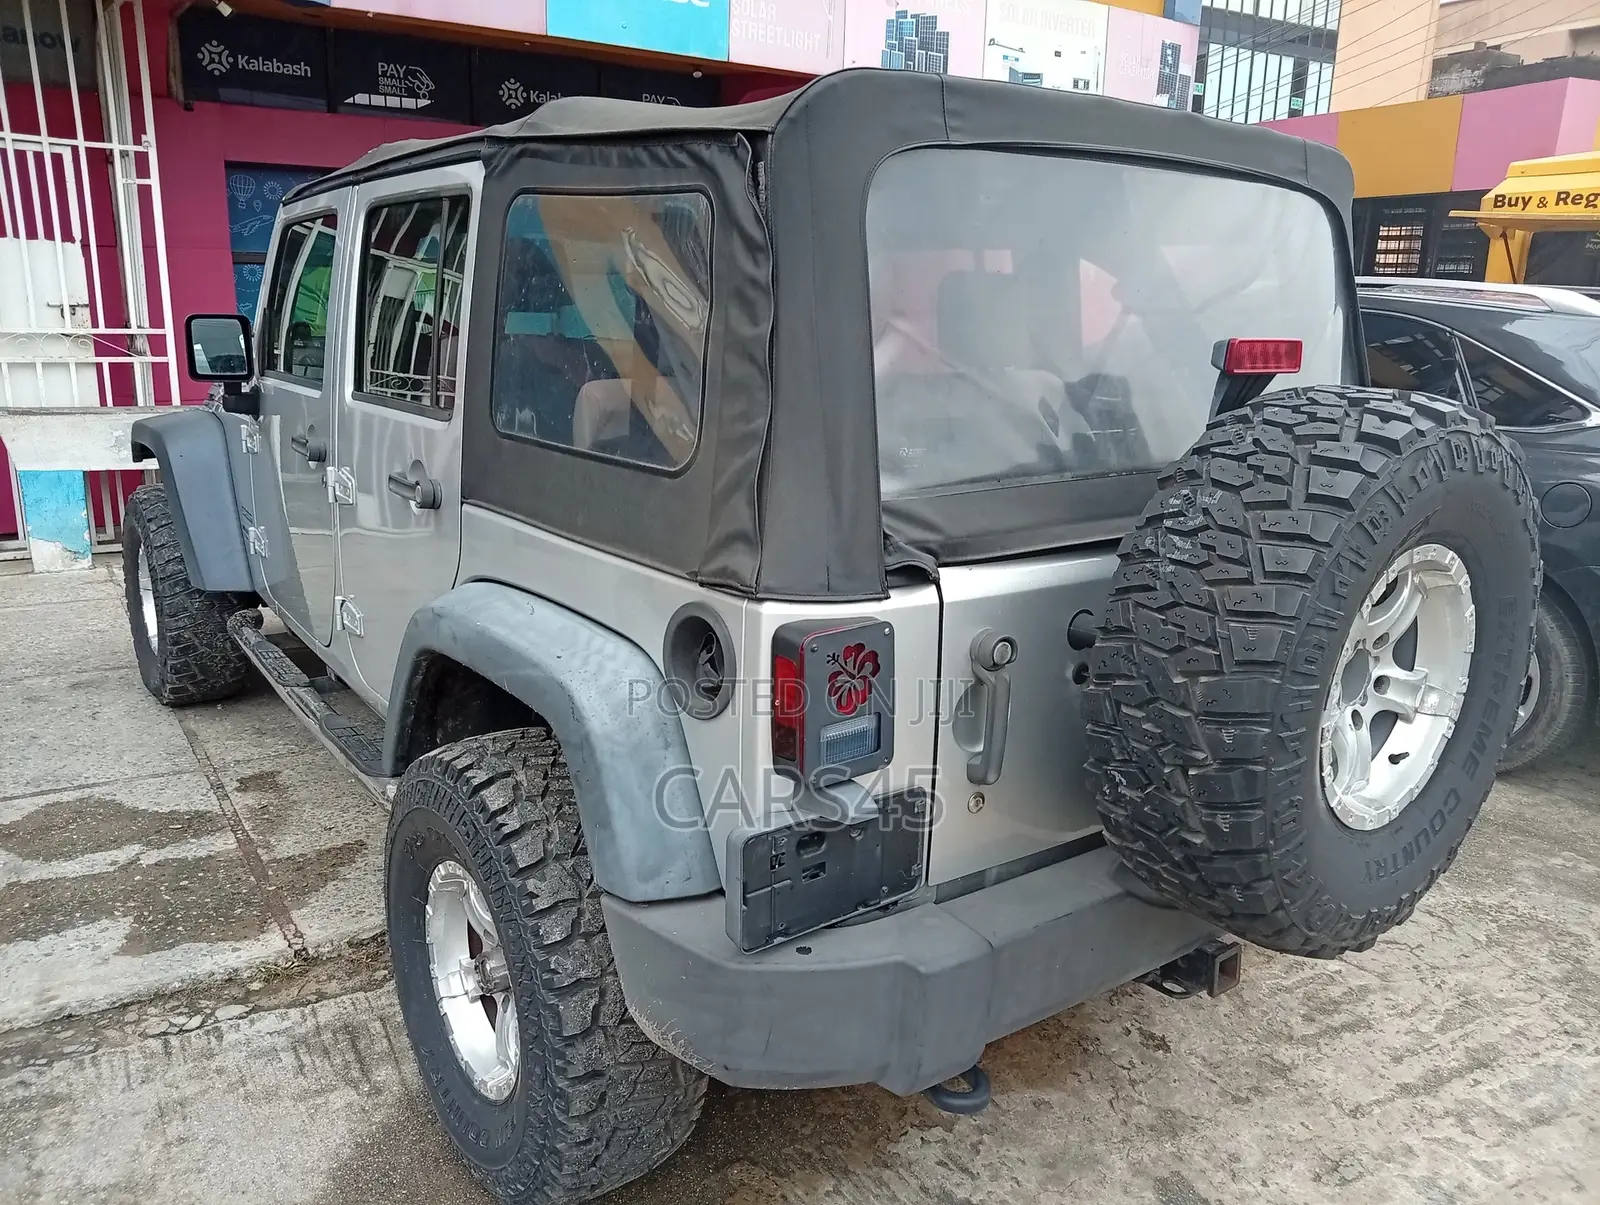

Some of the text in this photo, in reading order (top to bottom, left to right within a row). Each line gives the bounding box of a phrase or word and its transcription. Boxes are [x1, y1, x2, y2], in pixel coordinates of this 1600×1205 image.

[731, 0, 777, 22] SOLAR
[1040, 8, 1096, 38] INVERTER
[731, 18, 821, 53] STREETLIGHT
[237, 53, 312, 78] Kalabash
[378, 62, 407, 78] PAY
[378, 76, 408, 88] SMALL
[378, 85, 408, 96] SMALL
[1493, 190, 1600, 211] Buy & Reg
[1465, 594, 1519, 783] EXTREME
[1360, 786, 1463, 884] COUNTRY
